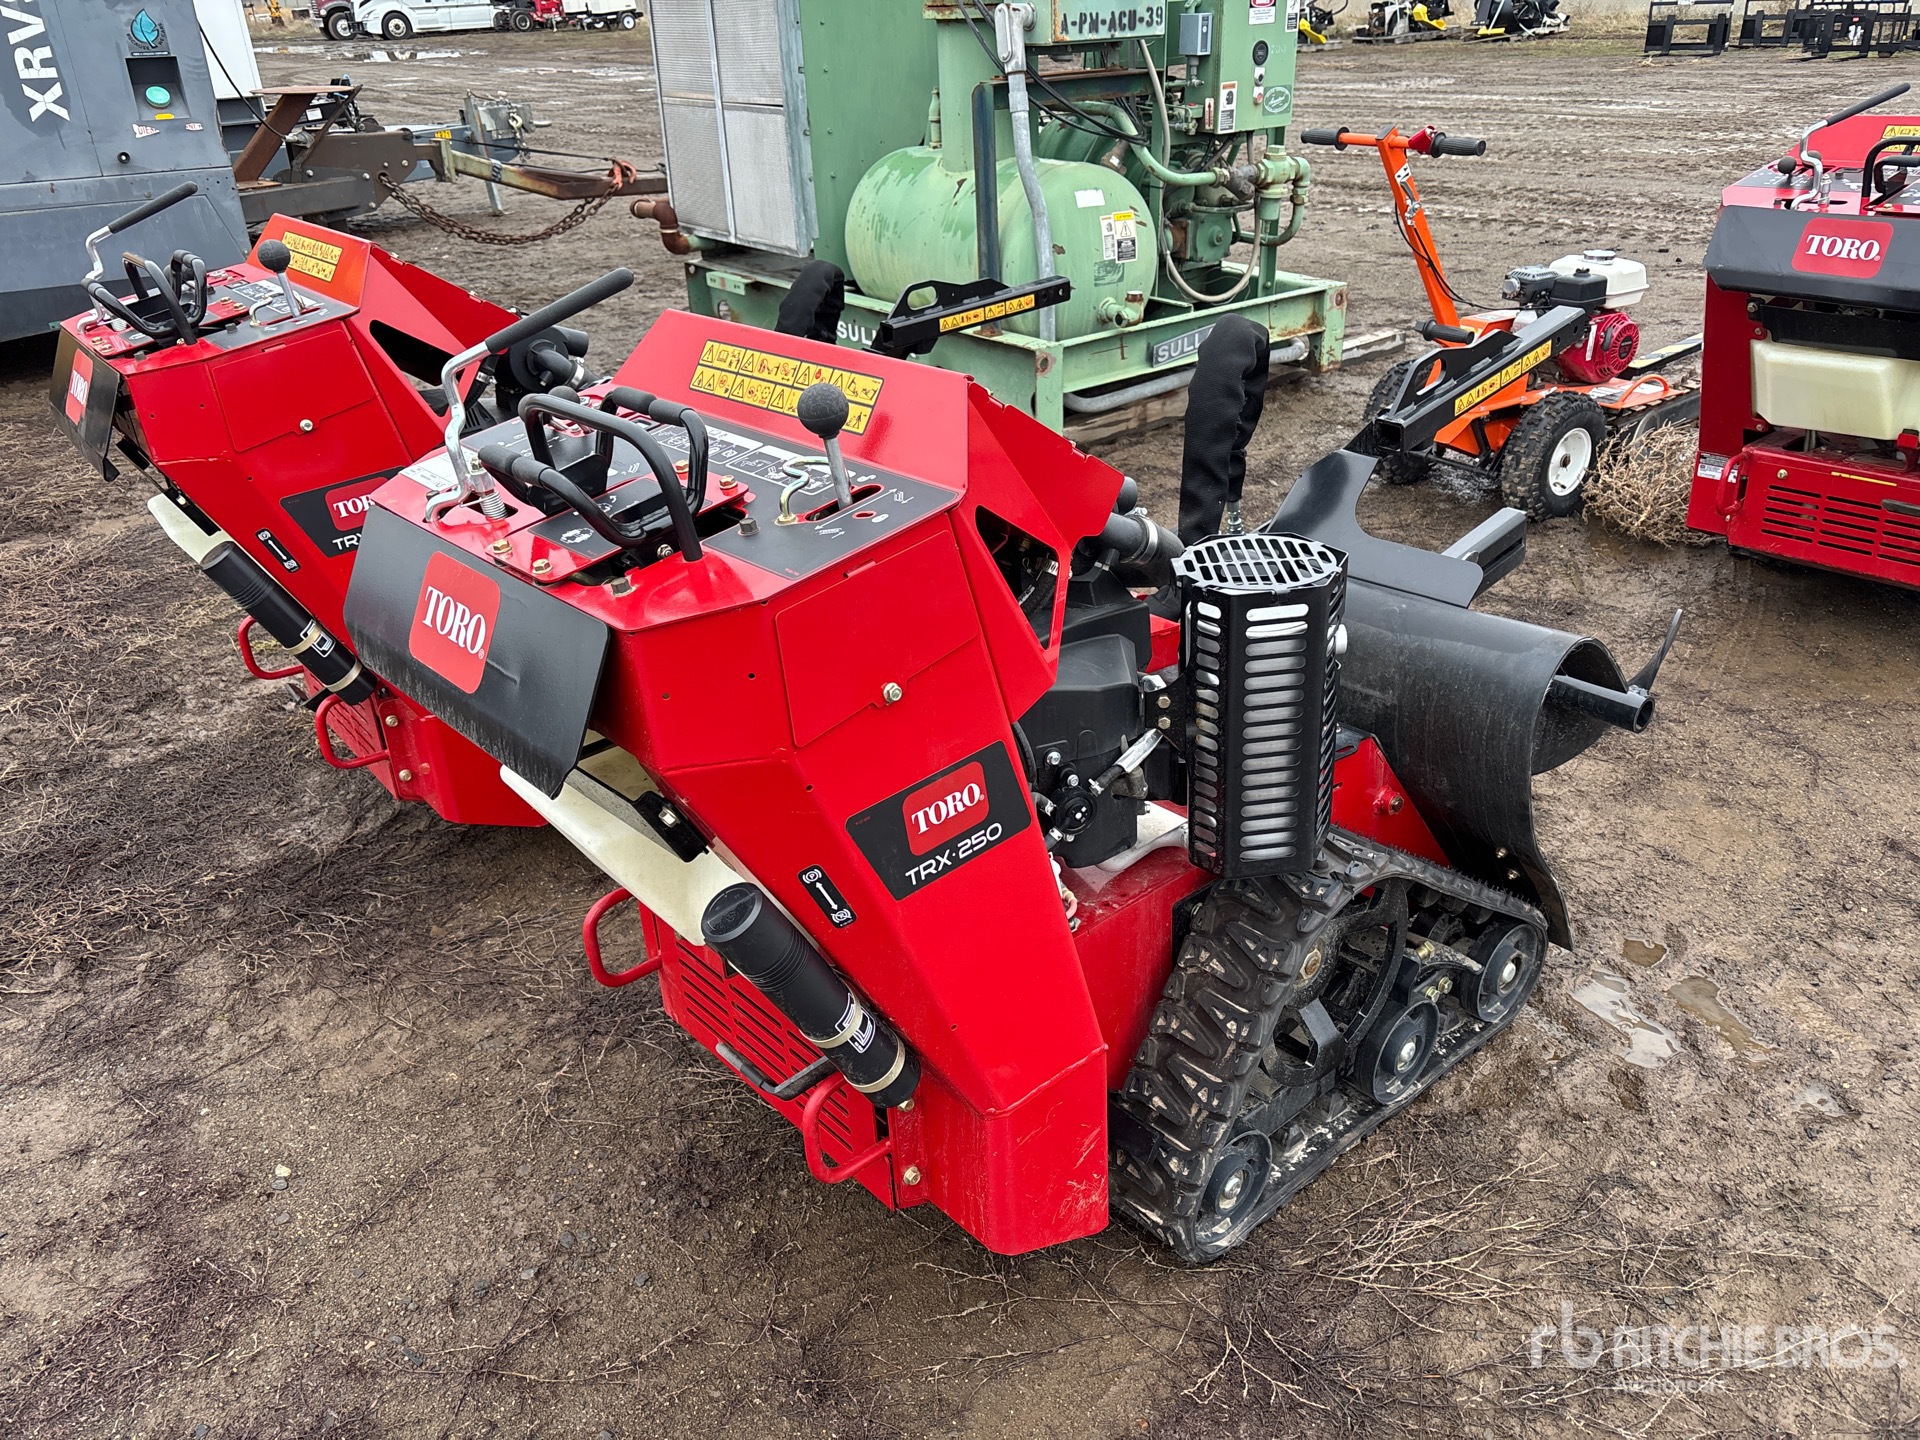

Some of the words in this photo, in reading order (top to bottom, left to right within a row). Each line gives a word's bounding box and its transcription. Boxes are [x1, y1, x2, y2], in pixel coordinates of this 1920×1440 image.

[1060, 5, 1164, 34] A-PM-ACU-39
[0, 0, 70, 122] XRV
[1805, 234, 1880, 261] TORO
[69, 369, 88, 405] TORO
[333, 494, 376, 518] TOR
[422, 585, 487, 655] TORO
[911, 782, 981, 835] TORO
